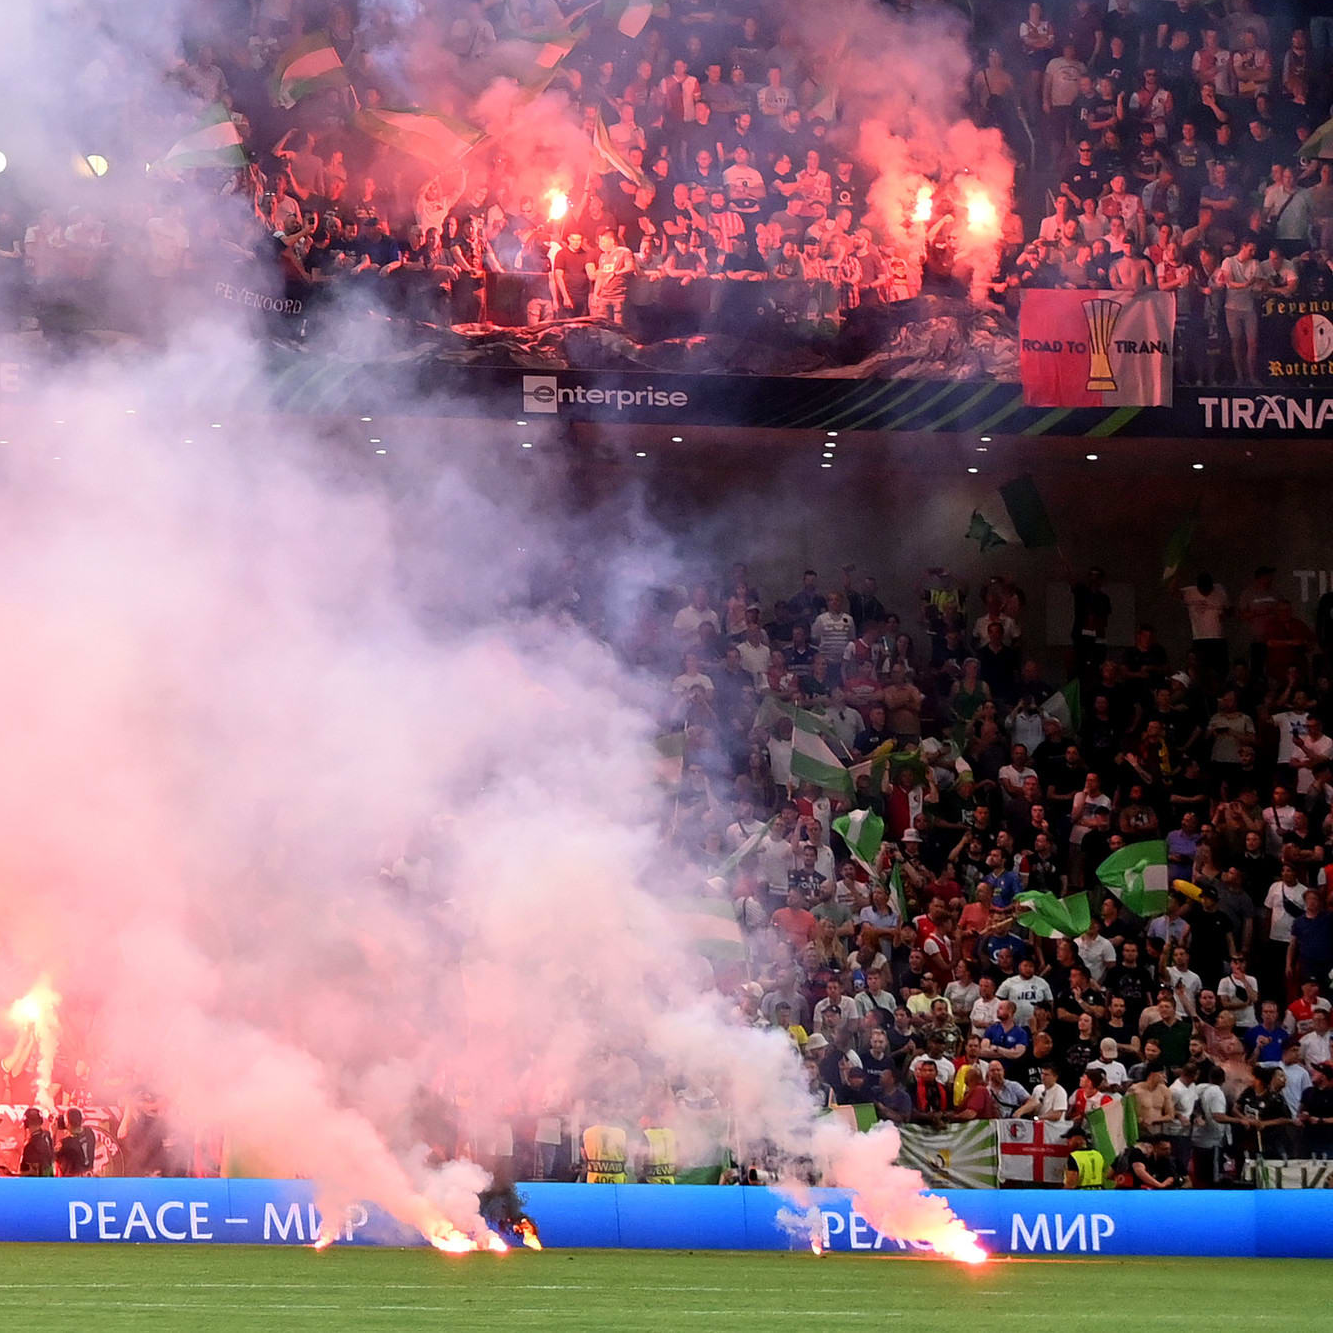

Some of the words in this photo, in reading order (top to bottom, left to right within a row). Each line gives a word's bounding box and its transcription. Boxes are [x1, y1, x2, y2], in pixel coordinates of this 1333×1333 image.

[1022, 339, 1063, 353] ROAD
[1066, 340, 1087, 354] TO
[1114, 340, 1169, 356] TIRANA
[532, 384, 689, 410] enterprise
[68, 1200, 213, 1240] PEACE
